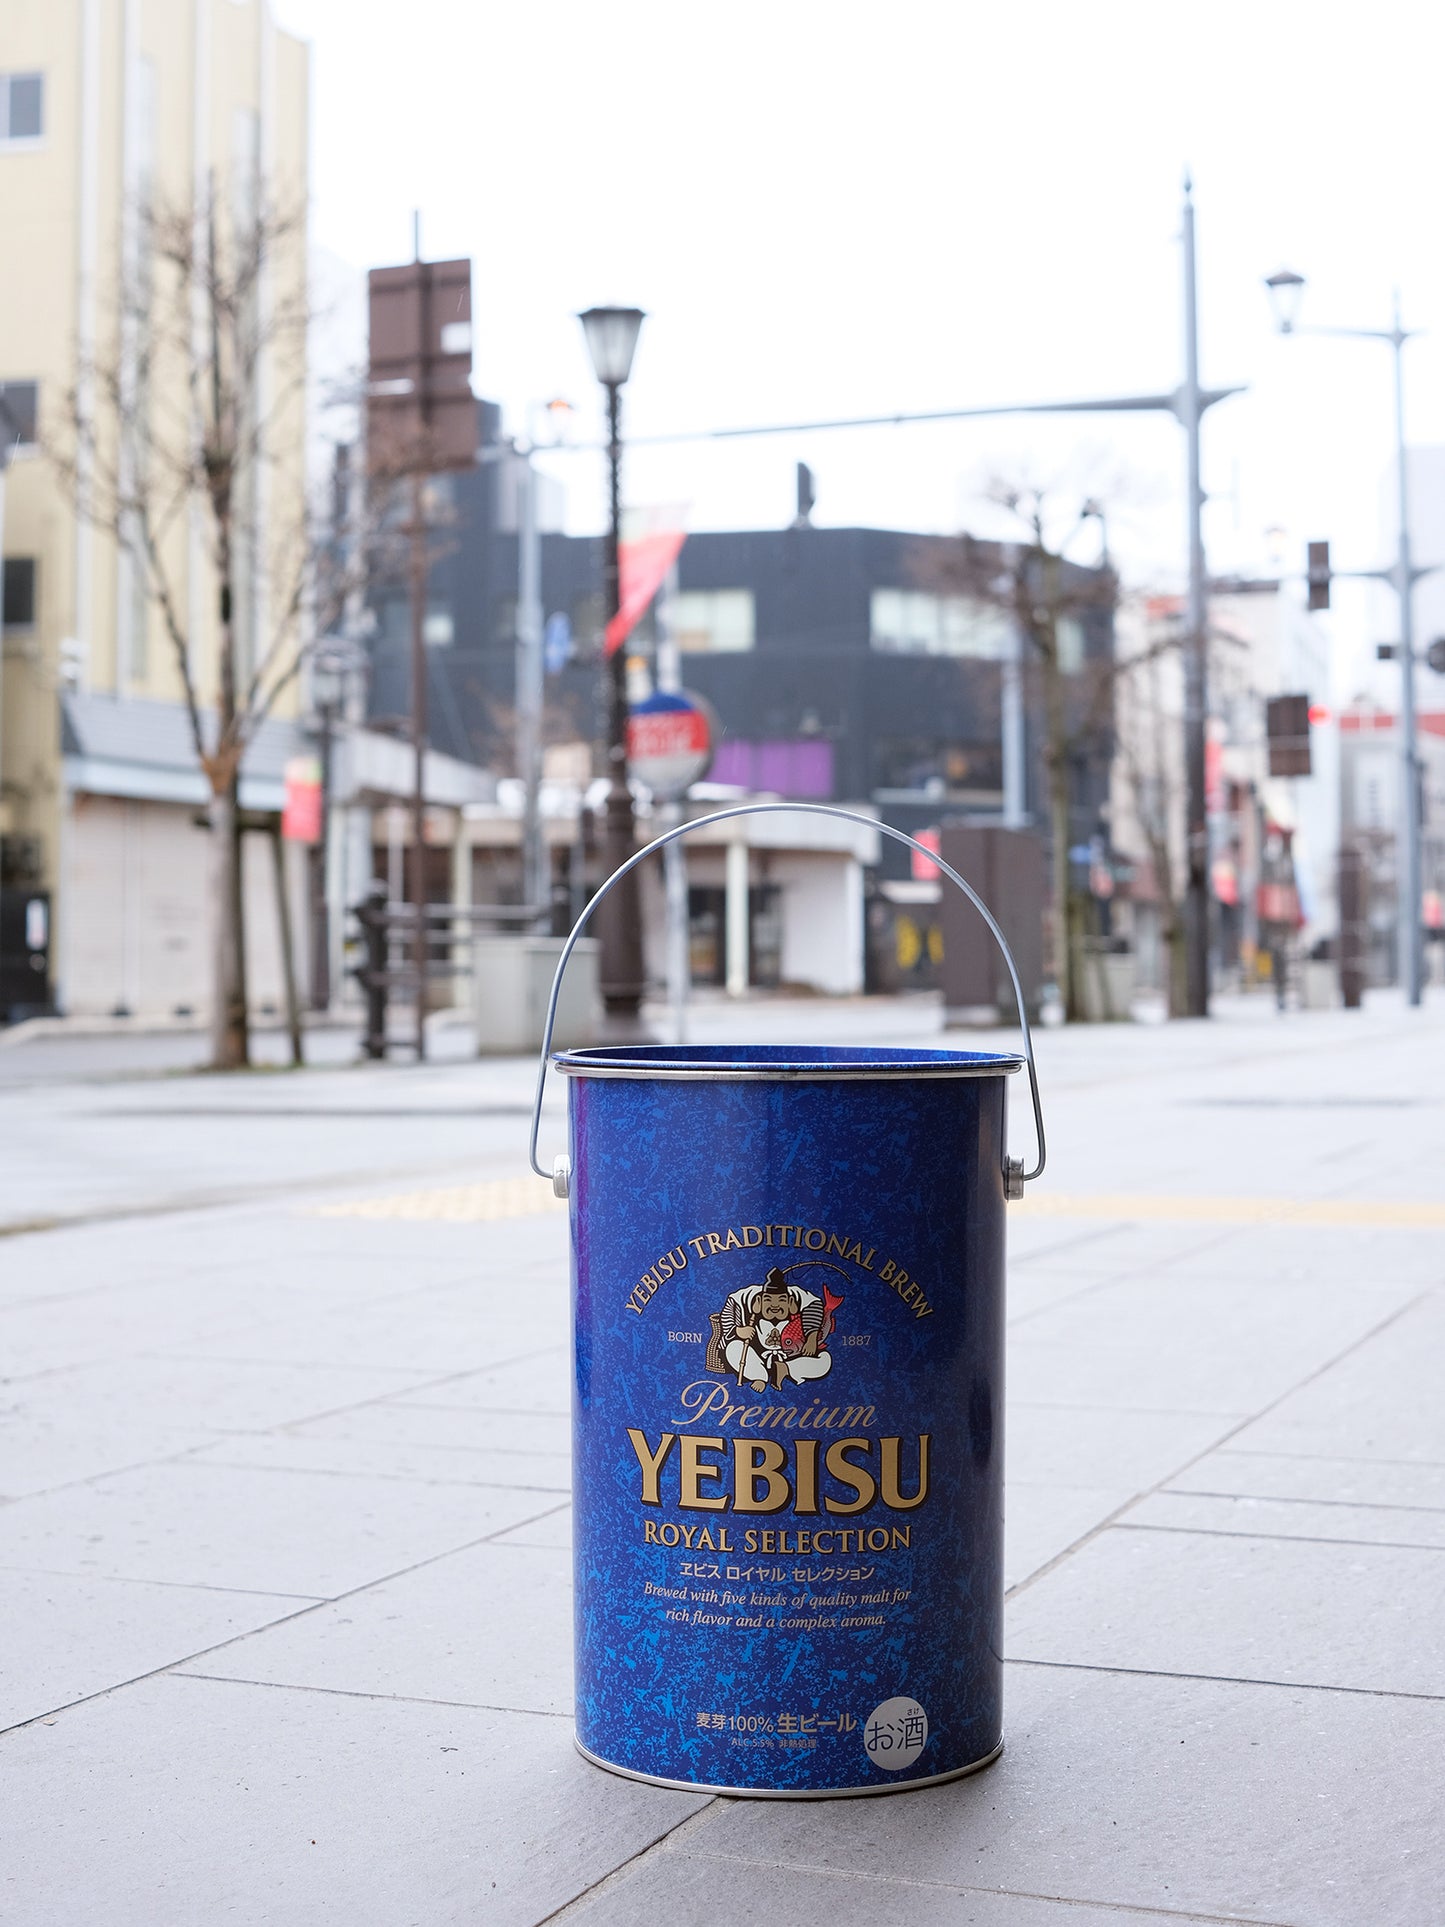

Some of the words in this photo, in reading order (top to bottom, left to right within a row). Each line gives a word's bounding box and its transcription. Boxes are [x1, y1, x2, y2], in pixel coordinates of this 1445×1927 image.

[625, 1245, 688, 1315] YEBISU
[688, 1224, 876, 1271] TRADITIONAL
[878, 1258, 934, 1320] BREW
[668, 1331, 702, 1343] BORN
[842, 1335, 871, 1346] 1887
[671, 1380, 877, 1429] Premium
[627, 1428, 931, 1516] YEBISU
[643, 1519, 734, 1552] ROYAL
[743, 1525, 912, 1555] SELECTION
[726, 1566, 786, 1582] ロイヤル
[791, 1566, 875, 1582] セレクション
[644, 1581, 688, 1600] Brewed
[690, 1589, 718, 1603] with
[719, 1590, 746, 1606] five
[750, 1592, 787, 1606] kinds
[791, 1592, 808, 1609] of
[809, 1592, 858, 1609] quality
[860, 1589, 890, 1604] malt
[890, 1587, 912, 1605] for
[665, 1607, 690, 1622] rich
[691, 1609, 733, 1626] flavor
[735, 1614, 763, 1628] and
[765, 1618, 775, 1628] a
[779, 1615, 837, 1631] complex
[840, 1615, 887, 1627] aroma.
[777, 1712, 857, 1733] 生ビール
[867, 1714, 925, 1751] お酒
